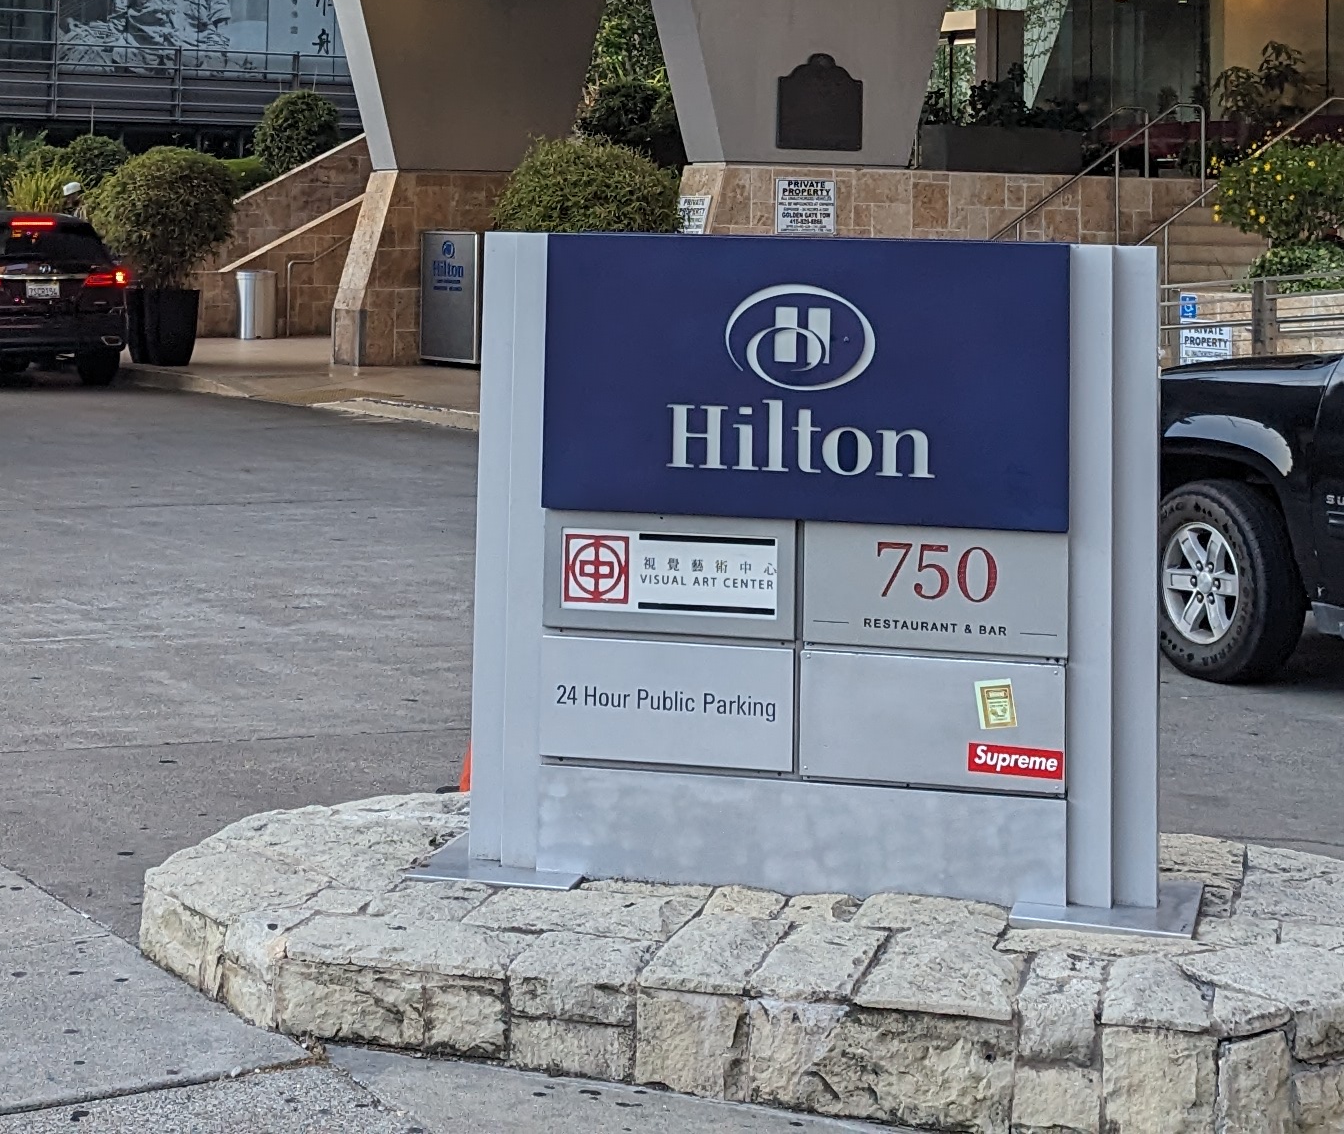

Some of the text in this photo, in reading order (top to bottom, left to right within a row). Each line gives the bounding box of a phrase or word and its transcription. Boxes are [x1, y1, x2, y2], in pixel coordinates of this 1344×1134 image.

[782, 188, 831, 197] PROPERTY
[787, 180, 826, 189] PRIVATE
[433, 260, 464, 277] Hilton
[1184, 336, 1229, 349] PROPERTY
[665, 399, 936, 479] Hilton
[643, 556, 777, 576] 視覺藝術中心
[877, 541, 998, 603] 750
[640, 574, 774, 590] VISUAL ART CENTER
[863, 618, 1007, 636] RESTAURANT & BAR
[556, 684, 776, 722] 24 Hour Public Parking
[974, 745, 1058, 772] Supreme
